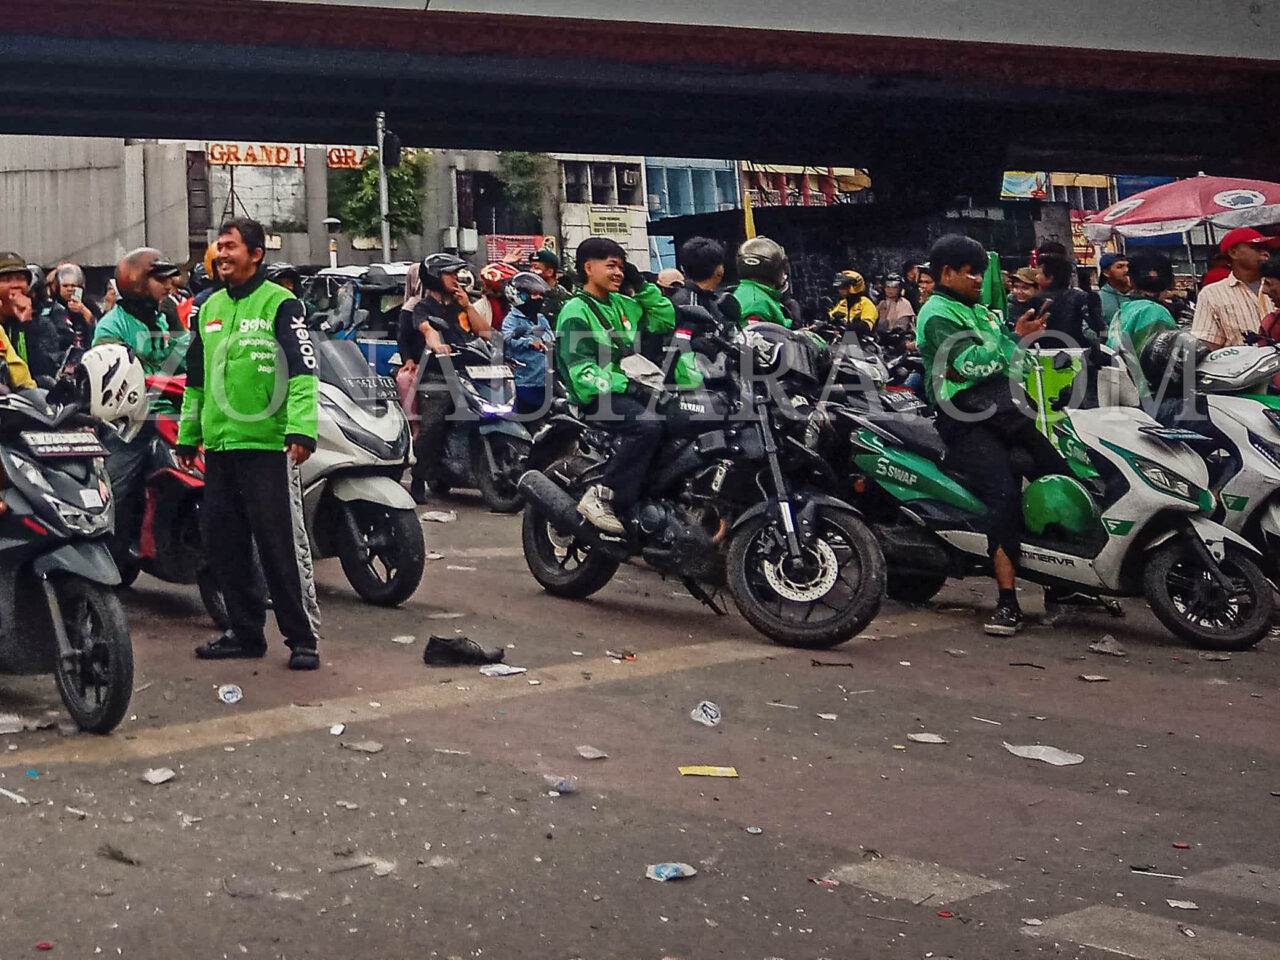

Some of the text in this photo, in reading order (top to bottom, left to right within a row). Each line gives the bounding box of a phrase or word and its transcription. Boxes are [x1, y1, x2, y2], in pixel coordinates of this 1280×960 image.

[210, 142, 290, 165] GRAND
[1209, 348, 1240, 361] Grab
[961, 359, 1003, 377] Grab
[680, 401, 705, 414] YAMAHA
[887, 465, 918, 485] SWAP
